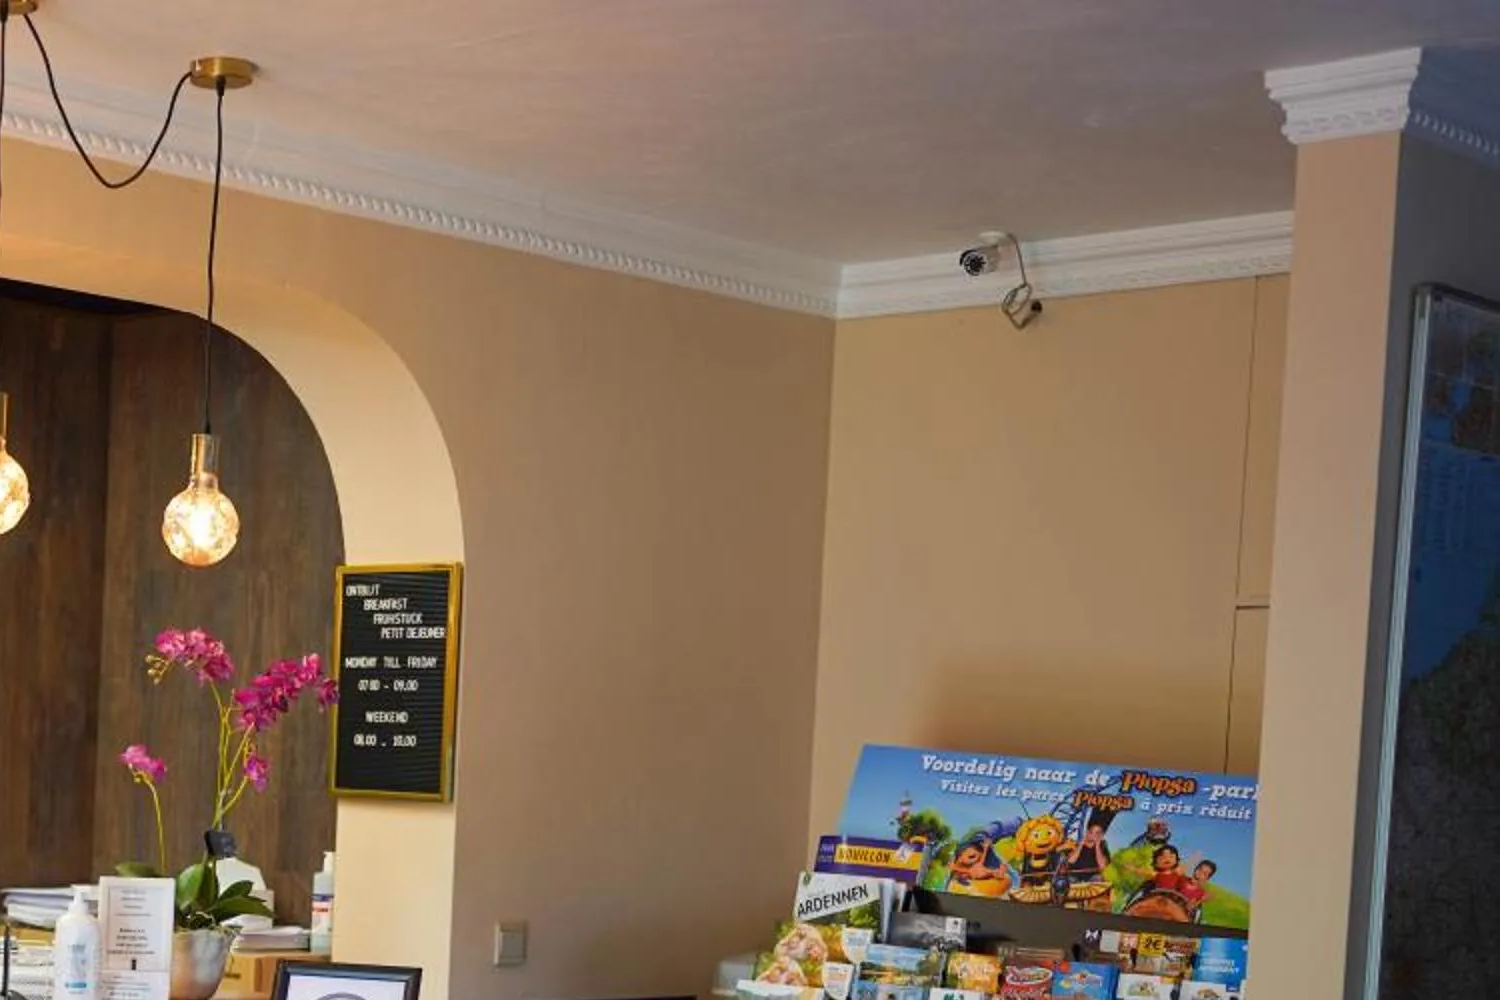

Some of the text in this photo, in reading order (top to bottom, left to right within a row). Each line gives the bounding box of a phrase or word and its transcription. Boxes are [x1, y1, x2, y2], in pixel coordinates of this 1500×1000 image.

[365, 711, 409, 724] WEEKEND
[921, 754, 1017, 782] Voordelig
[1024, 766, 1077, 784] naar
[1084, 768, 1111, 787] de
[798, 883, 868, 917] ARDENNEN
